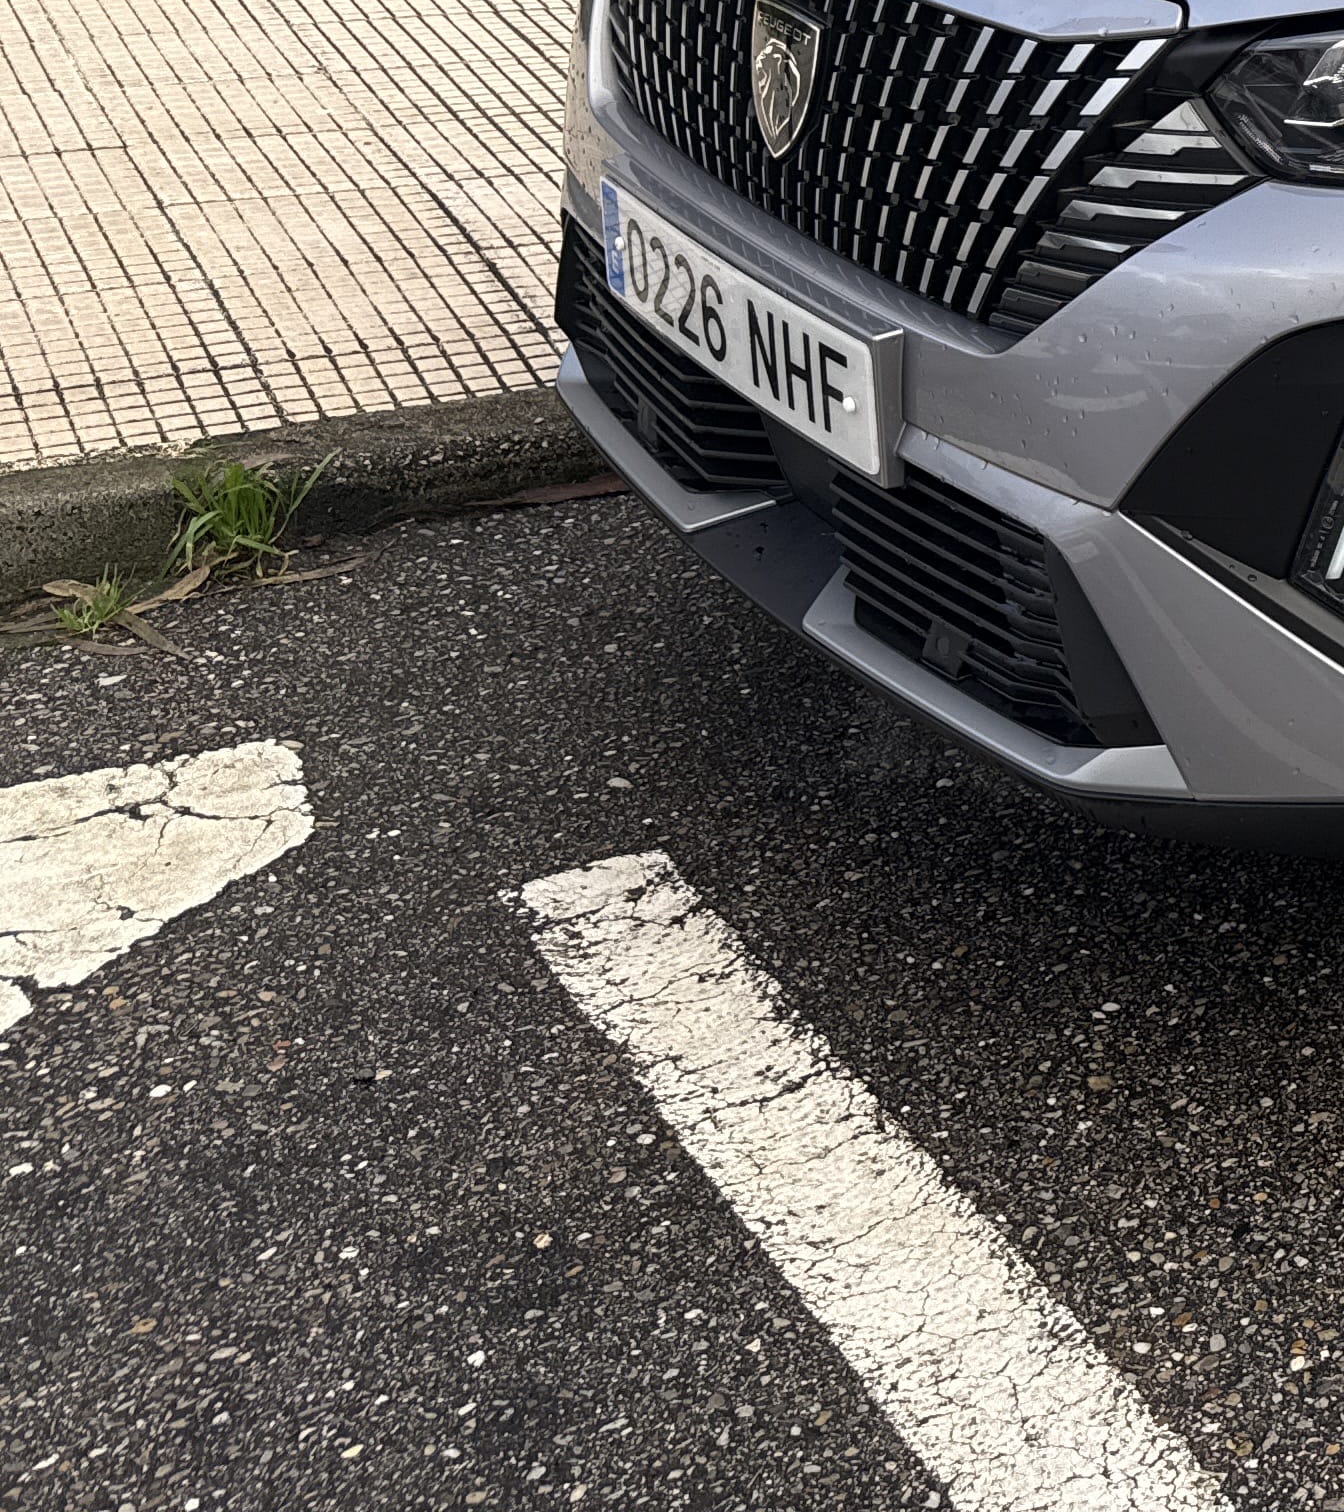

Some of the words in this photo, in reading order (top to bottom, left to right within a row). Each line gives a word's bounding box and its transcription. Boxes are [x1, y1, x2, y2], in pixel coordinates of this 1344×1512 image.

[757, 11, 812, 46] PEUGEOT
[626, 218, 728, 363] 0226
[747, 298, 849, 434] NHF
